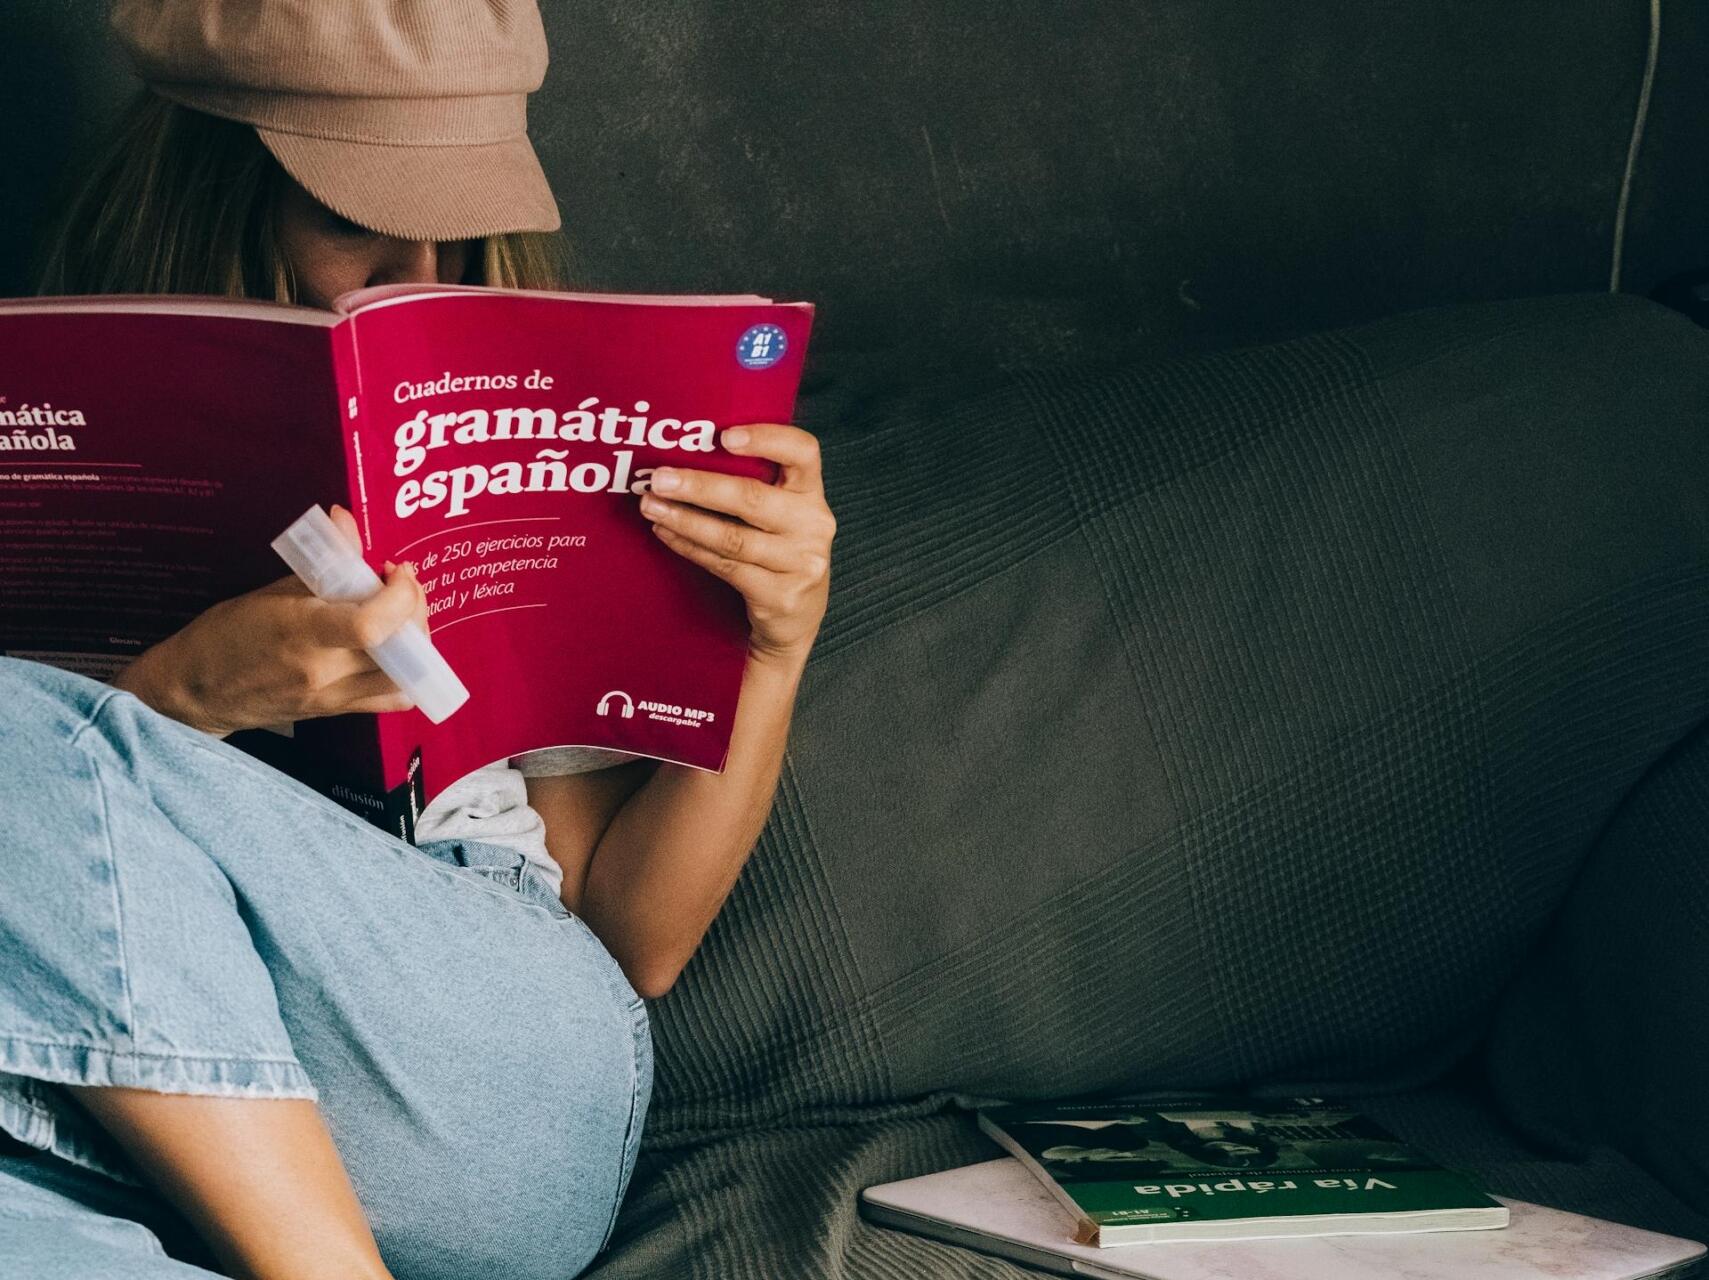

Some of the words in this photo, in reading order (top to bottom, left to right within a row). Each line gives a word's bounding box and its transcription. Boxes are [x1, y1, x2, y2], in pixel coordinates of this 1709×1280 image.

[752, 333, 772, 345] A1
[750, 345, 770, 358] B1
[393, 371, 518, 404] Cuadernos
[523, 369, 554, 390] de
[393, 396, 716, 477] gramática
[23, 473, 63, 482] gramática
[422, 551, 438, 571] de
[441, 540, 472, 563] 250
[475, 533, 544, 558] ejercicios
[547, 535, 587, 551] para
[441, 571, 456, 587] tu
[459, 554, 559, 579] competencia
[458, 590, 469, 609] y
[473, 580, 515, 600] léxica
[637, 700, 683, 716] AUDIO
[684, 707, 716, 723] MP3
[648, 712, 702, 728] descargable
[331, 784, 385, 811] difusión
[1133, 1178, 1298, 1198] rápida
[1312, 1178, 1398, 1191] Vía
